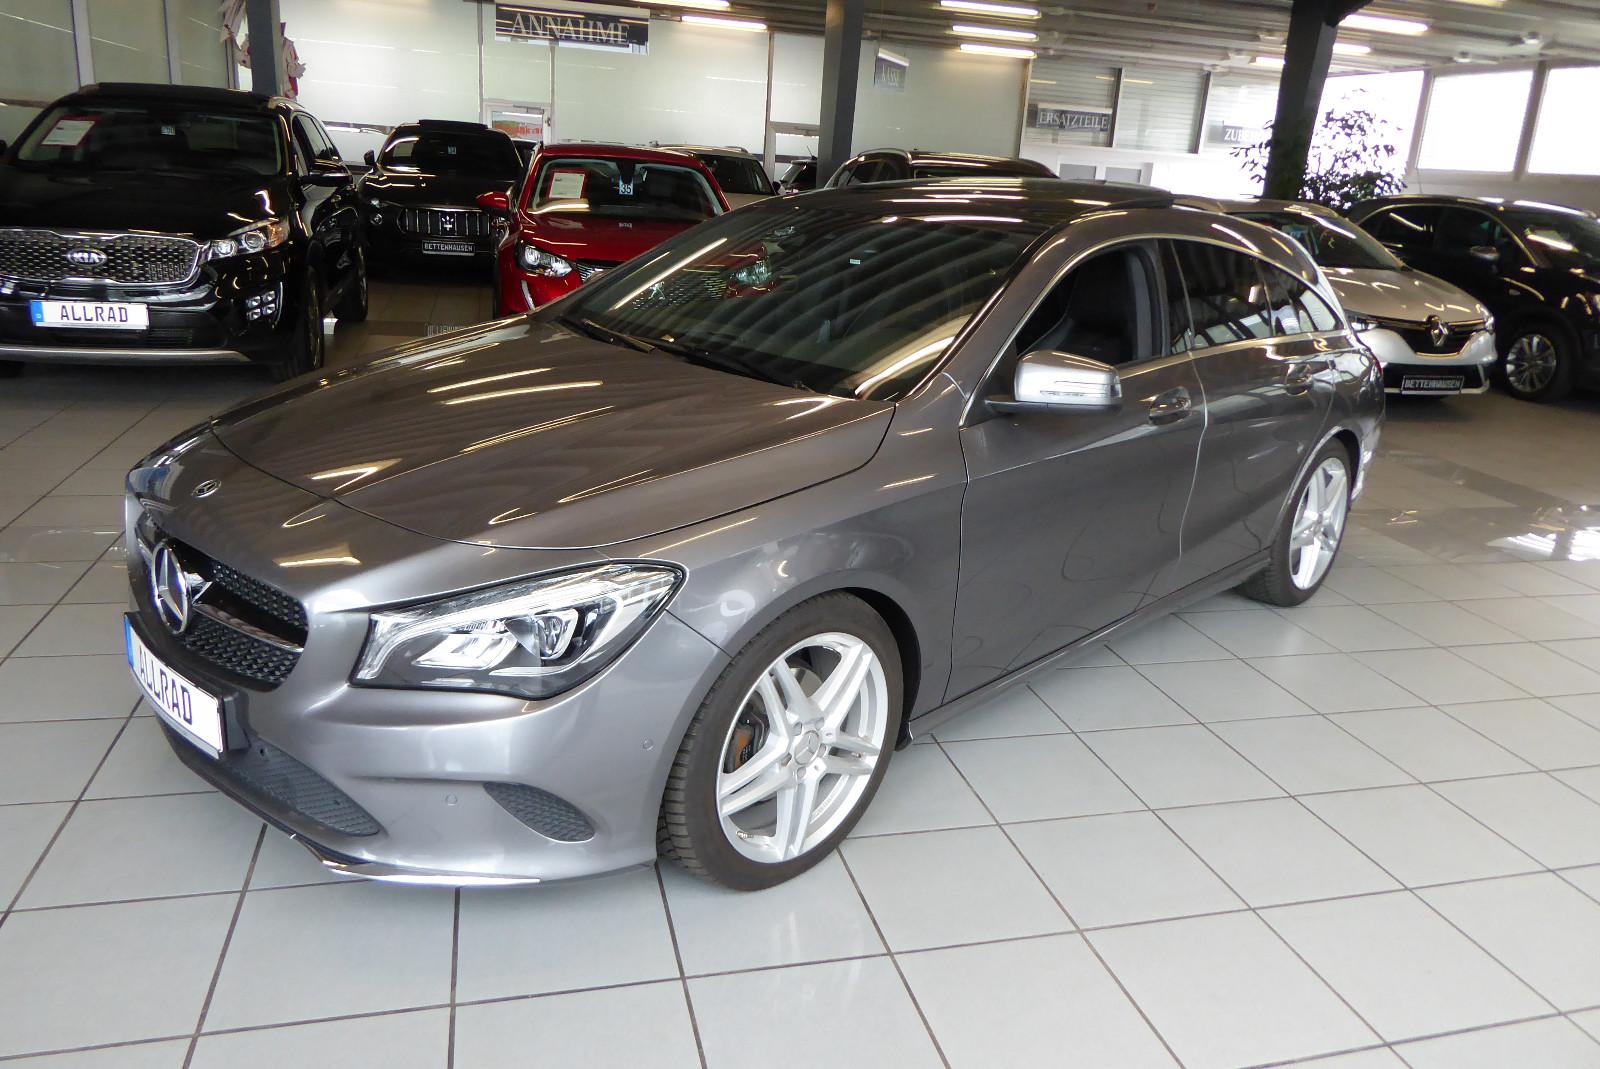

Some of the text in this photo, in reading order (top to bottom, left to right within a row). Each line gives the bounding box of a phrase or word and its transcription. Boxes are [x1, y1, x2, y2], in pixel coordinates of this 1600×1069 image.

[511, 13, 630, 46] ANNAHME
[1039, 111, 1109, 129] ERSATZTEILE
[424, 243, 473, 252] BETTENHAUSEN
[72, 252, 100, 263] KIA
[60, 305, 129, 322] ALLRAD
[1405, 379, 1461, 388] BETTENHAUSEN
[139, 645, 192, 725] ALLRAD
